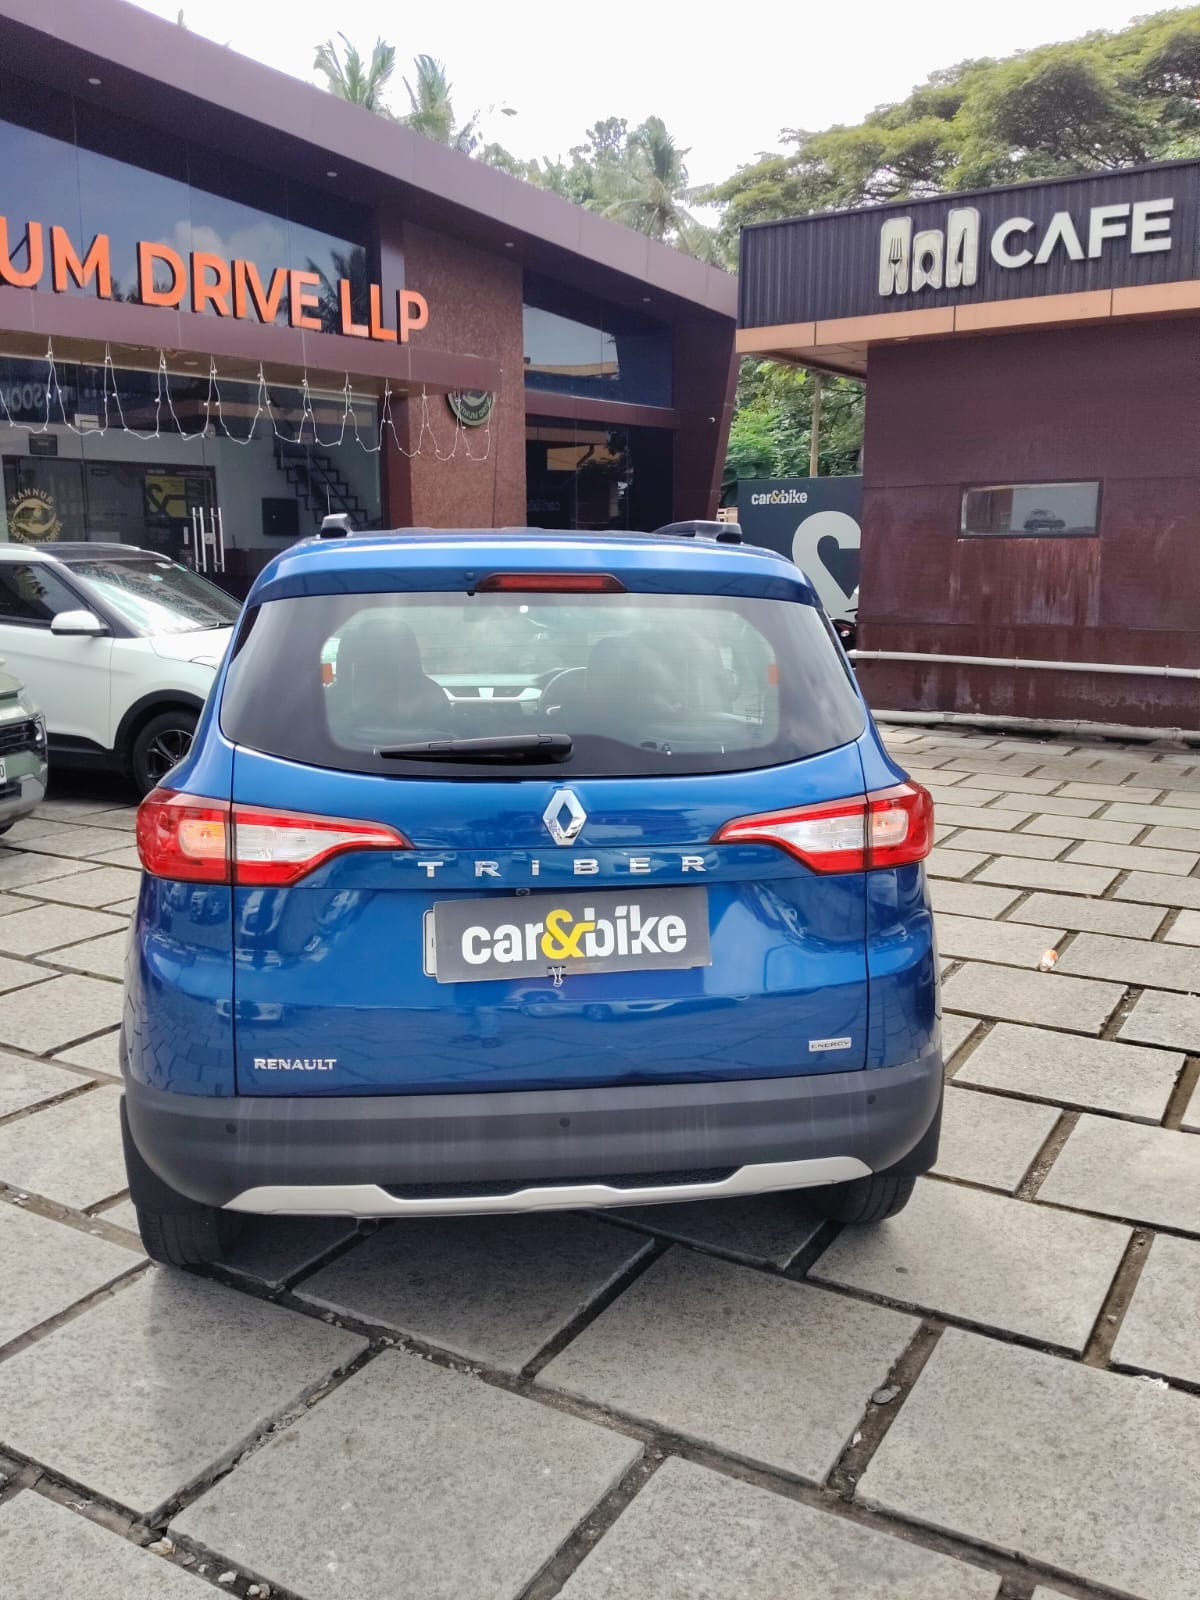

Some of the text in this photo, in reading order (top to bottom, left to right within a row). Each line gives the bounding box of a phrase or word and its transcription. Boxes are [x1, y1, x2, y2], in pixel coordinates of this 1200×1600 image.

[990, 198, 1174, 269] CAFE
[0, 215, 429, 344] UM DRIVE LLP
[10, 487, 54, 505] KANNUR
[751, 489, 808, 505] car&bike
[461, 904, 687, 966] car&bike
[810, 1040, 850, 1050] ENERGY
[253, 1058, 337, 1071] RENAULT
